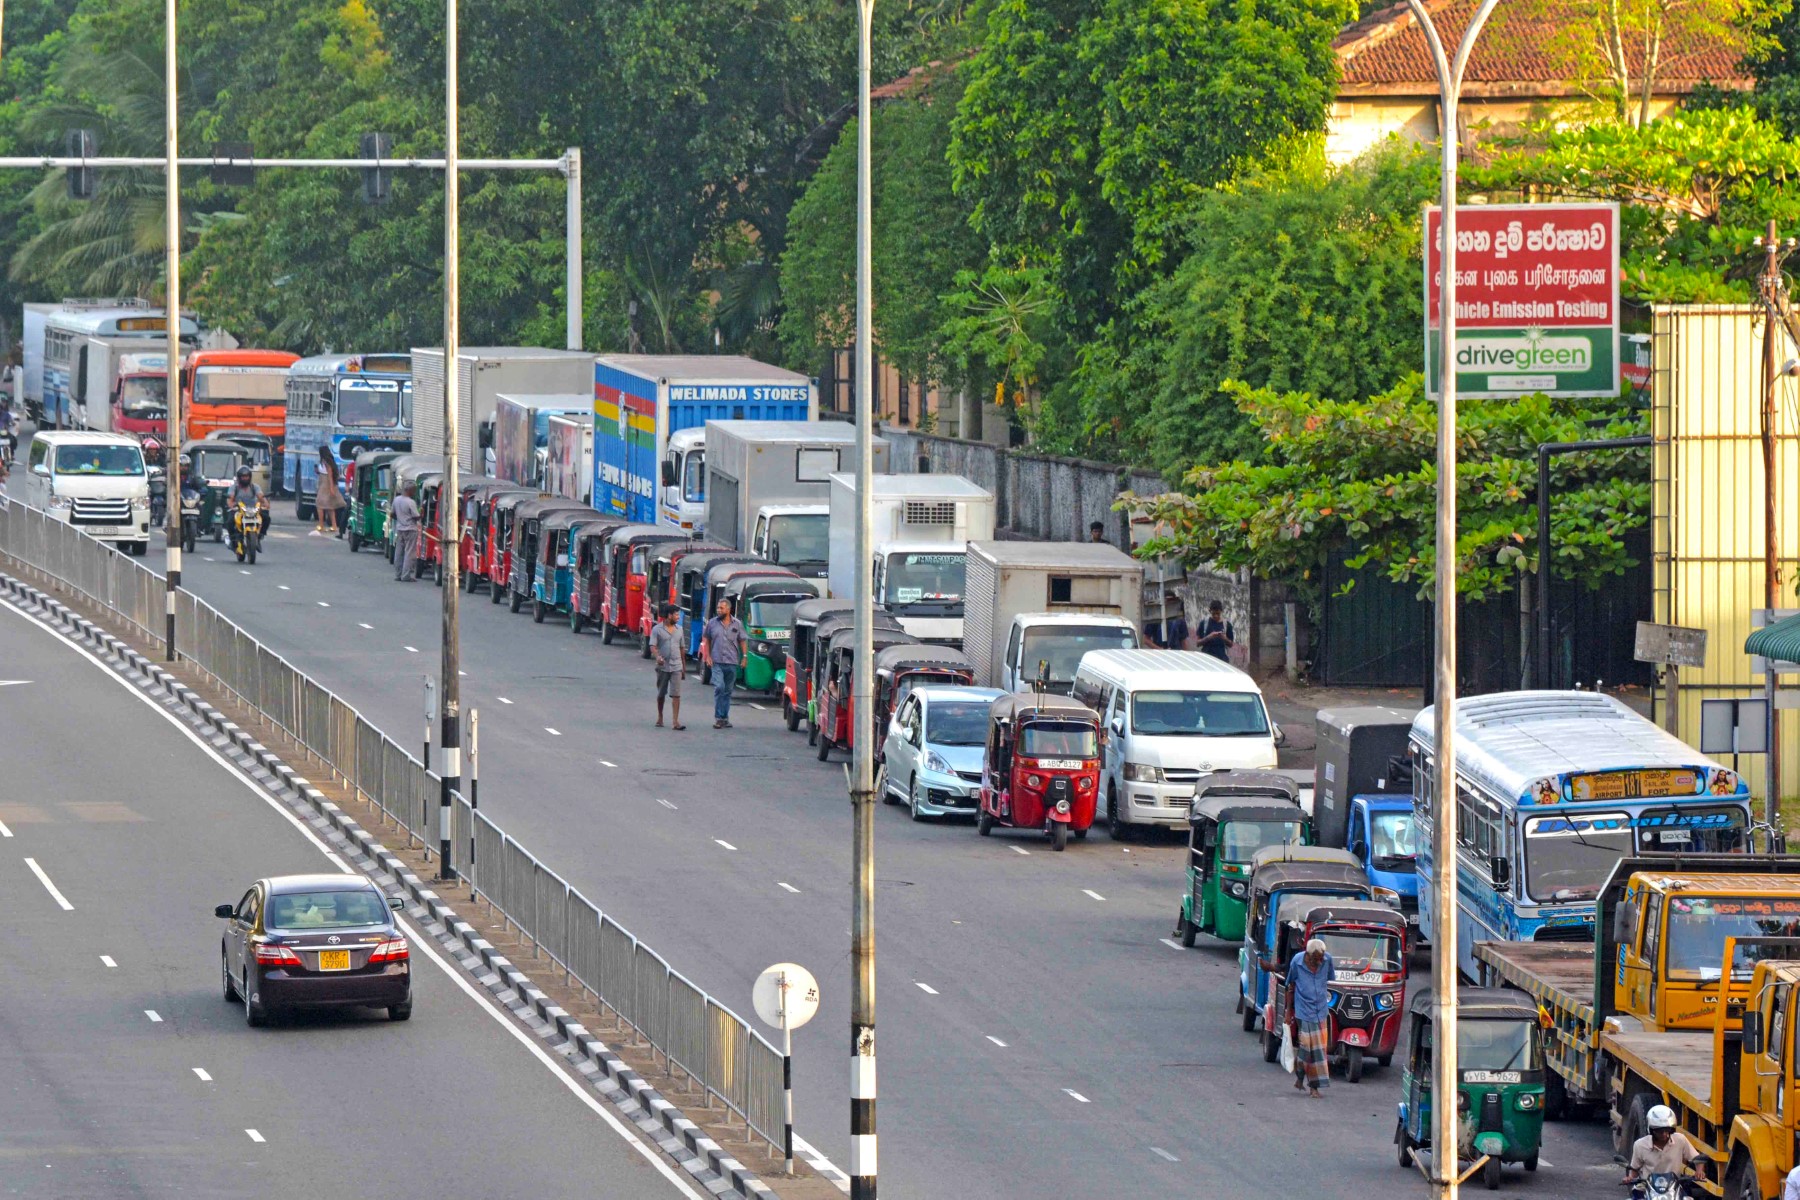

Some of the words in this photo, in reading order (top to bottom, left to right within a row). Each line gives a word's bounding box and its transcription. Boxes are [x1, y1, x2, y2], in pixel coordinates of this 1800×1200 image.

[1484, 270, 1518, 291] புகை
[1525, 263, 1606, 291] பரிசோதனை
[1437, 300, 1490, 319] hicle
[1492, 300, 1555, 319] Emission
[1556, 299, 1608, 320] Testing
[670, 387, 747, 401] WELIMADA
[752, 387, 808, 401] STORES
[1594, 791, 1623, 799] AIRPORT
[328, 951, 340, 960] KR
[1474, 1071, 1486, 1081] YB
[1496, 1072, 1519, 1082] 9627
